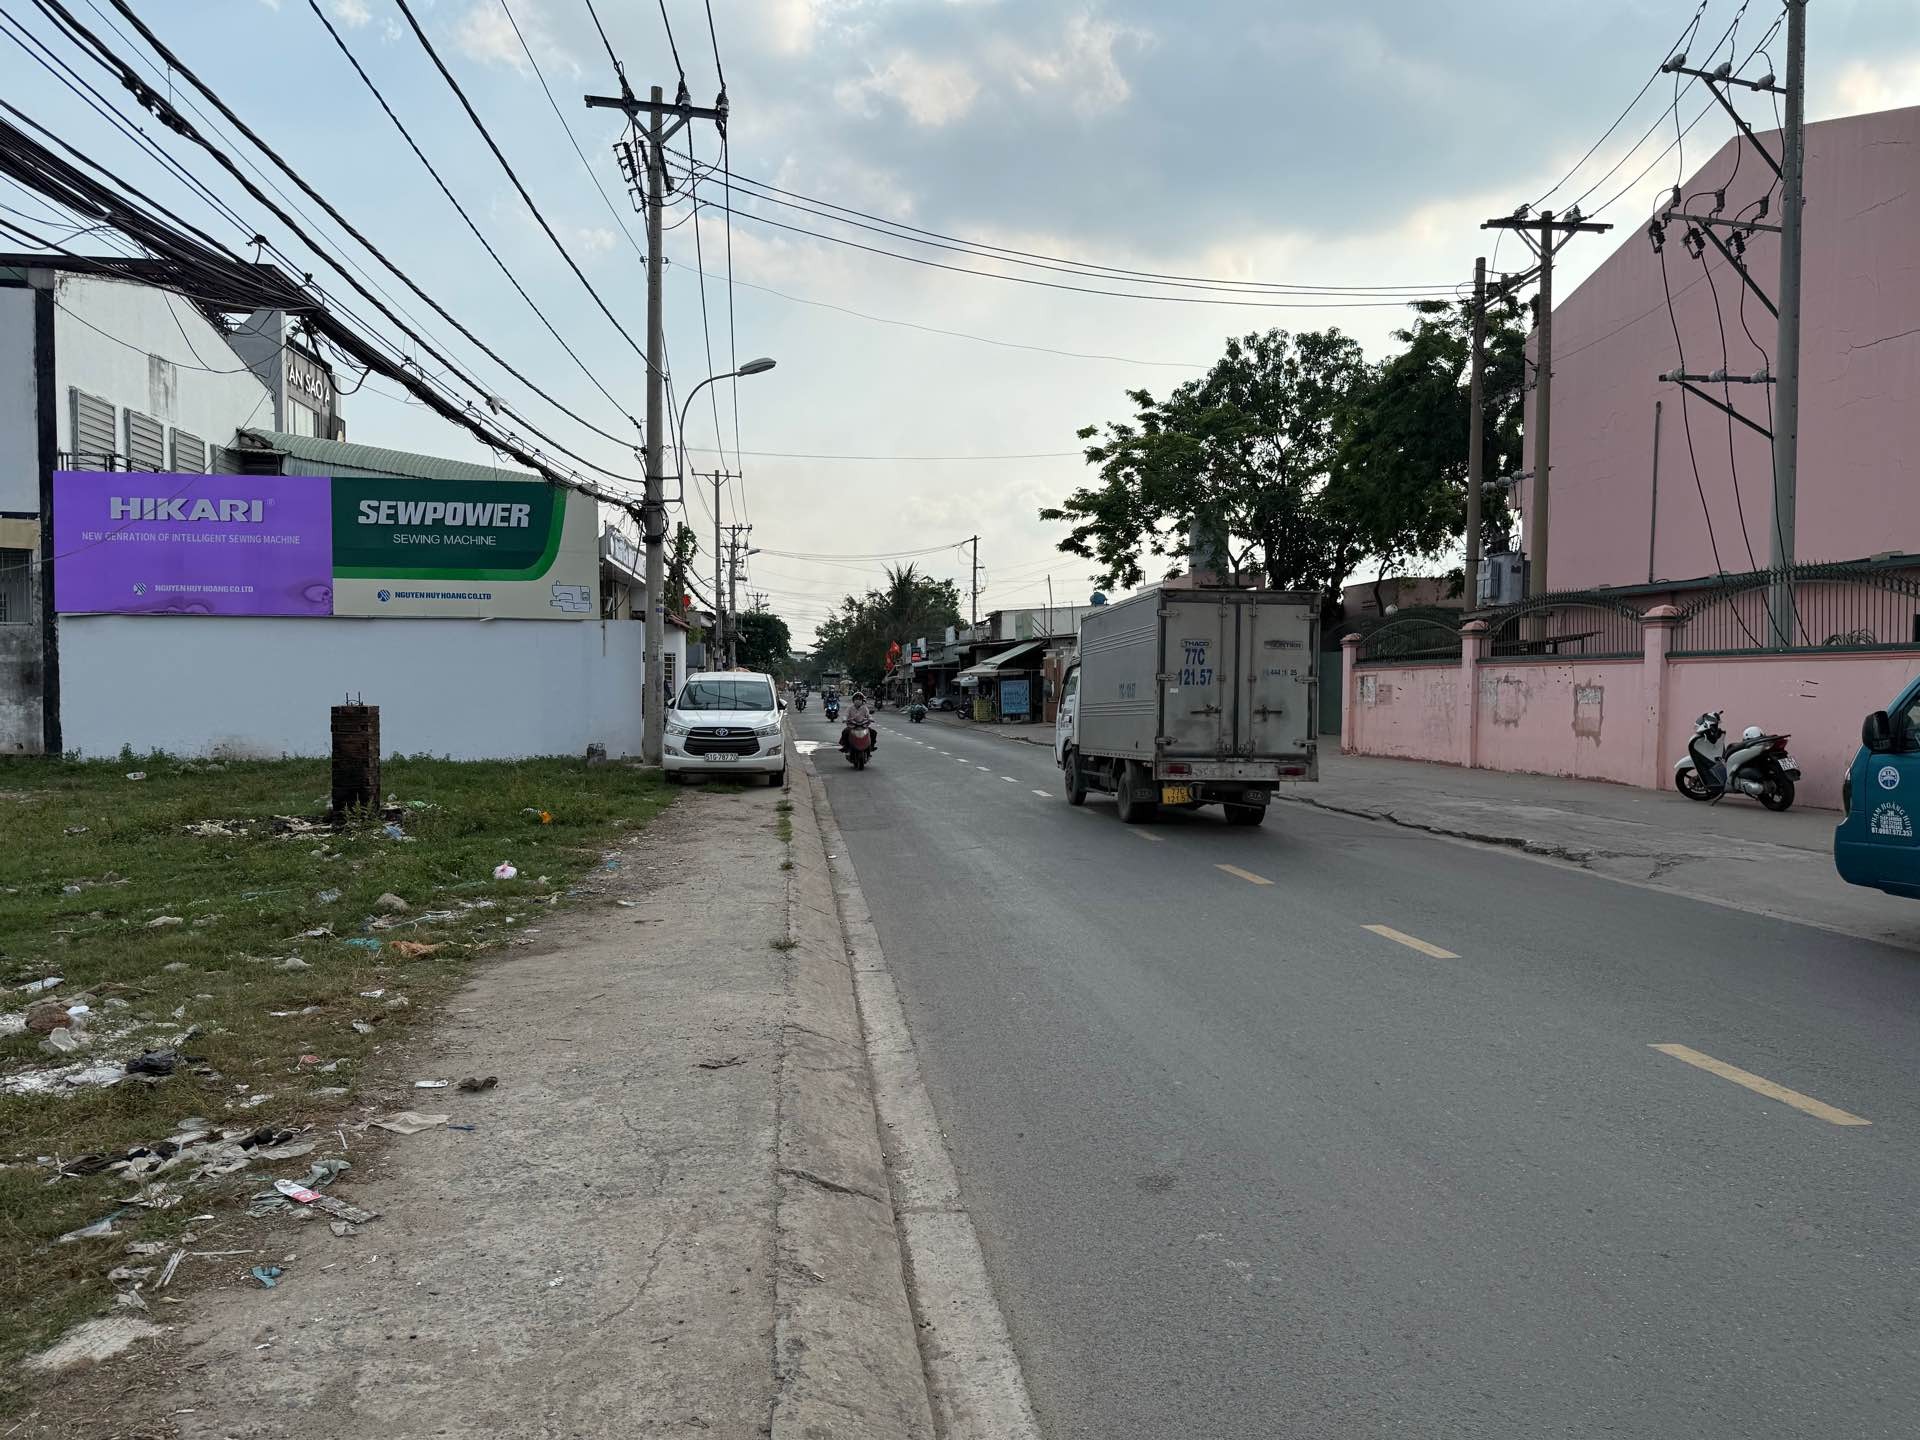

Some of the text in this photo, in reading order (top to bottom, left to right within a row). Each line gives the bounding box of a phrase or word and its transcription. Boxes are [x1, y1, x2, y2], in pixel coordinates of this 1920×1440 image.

[110, 496, 264, 522] HIKARI
[357, 499, 531, 528] SEWPOWER
[82, 530, 102, 541] NEW
[158, 532, 170, 542] OF
[171, 533, 227, 543] INTELLIGENT
[229, 534, 261, 544] SEWING
[263, 535, 300, 545] MACHINE
[393, 533, 496, 545] SEWING MACHINE
[395, 591, 425, 599] NGUYEN
[425, 591, 441, 599] HUY
[441, 592, 467, 600] HOANG
[1184, 648, 1206, 665] 77C
[1177, 668, 1213, 686] 121.57
